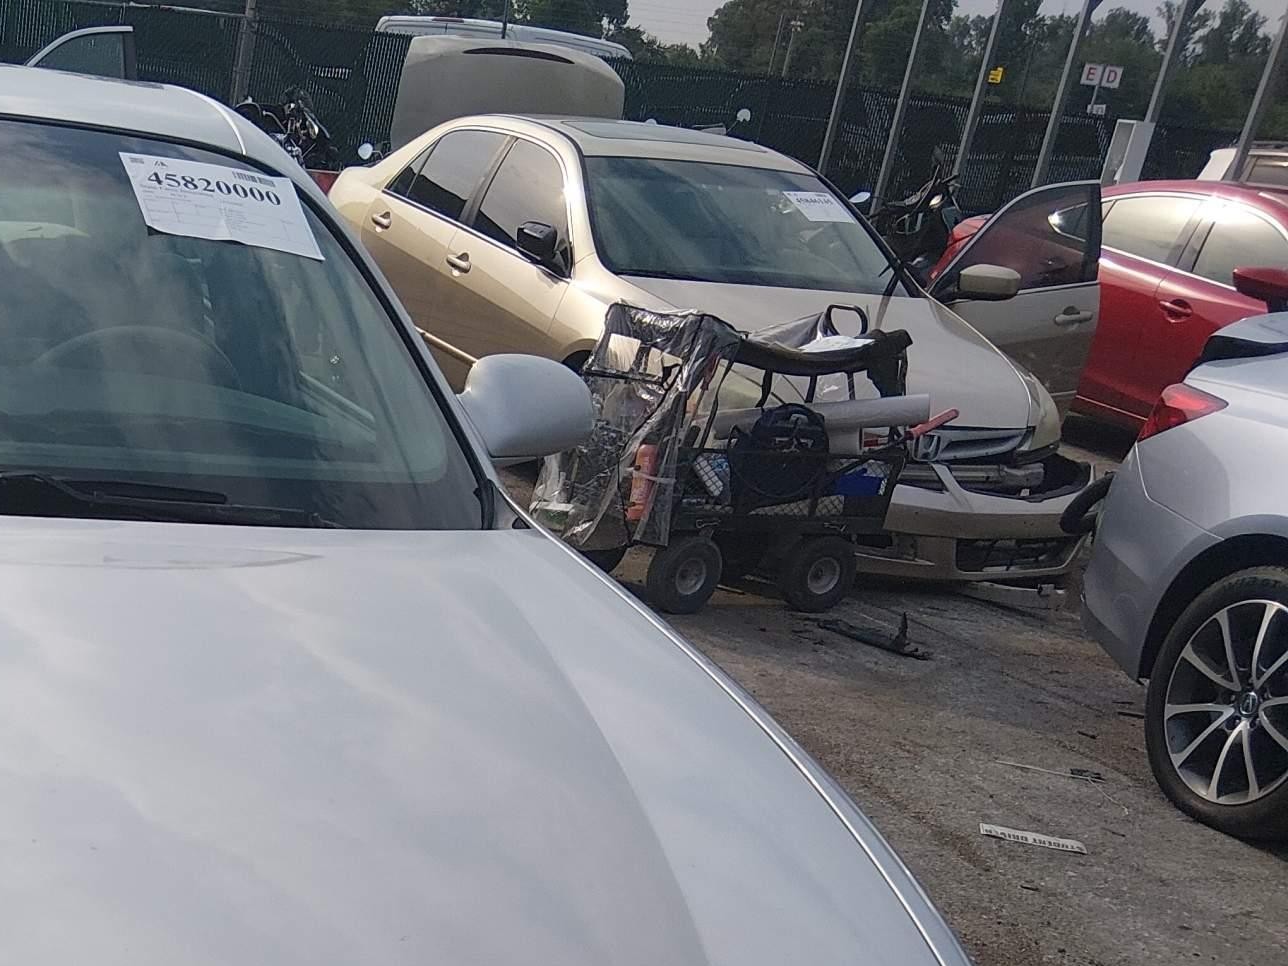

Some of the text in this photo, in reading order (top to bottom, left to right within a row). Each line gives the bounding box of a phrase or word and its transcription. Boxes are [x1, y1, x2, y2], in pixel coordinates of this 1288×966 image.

[1086, 67, 1118, 84] E D
[147, 171, 282, 206] 45820000
